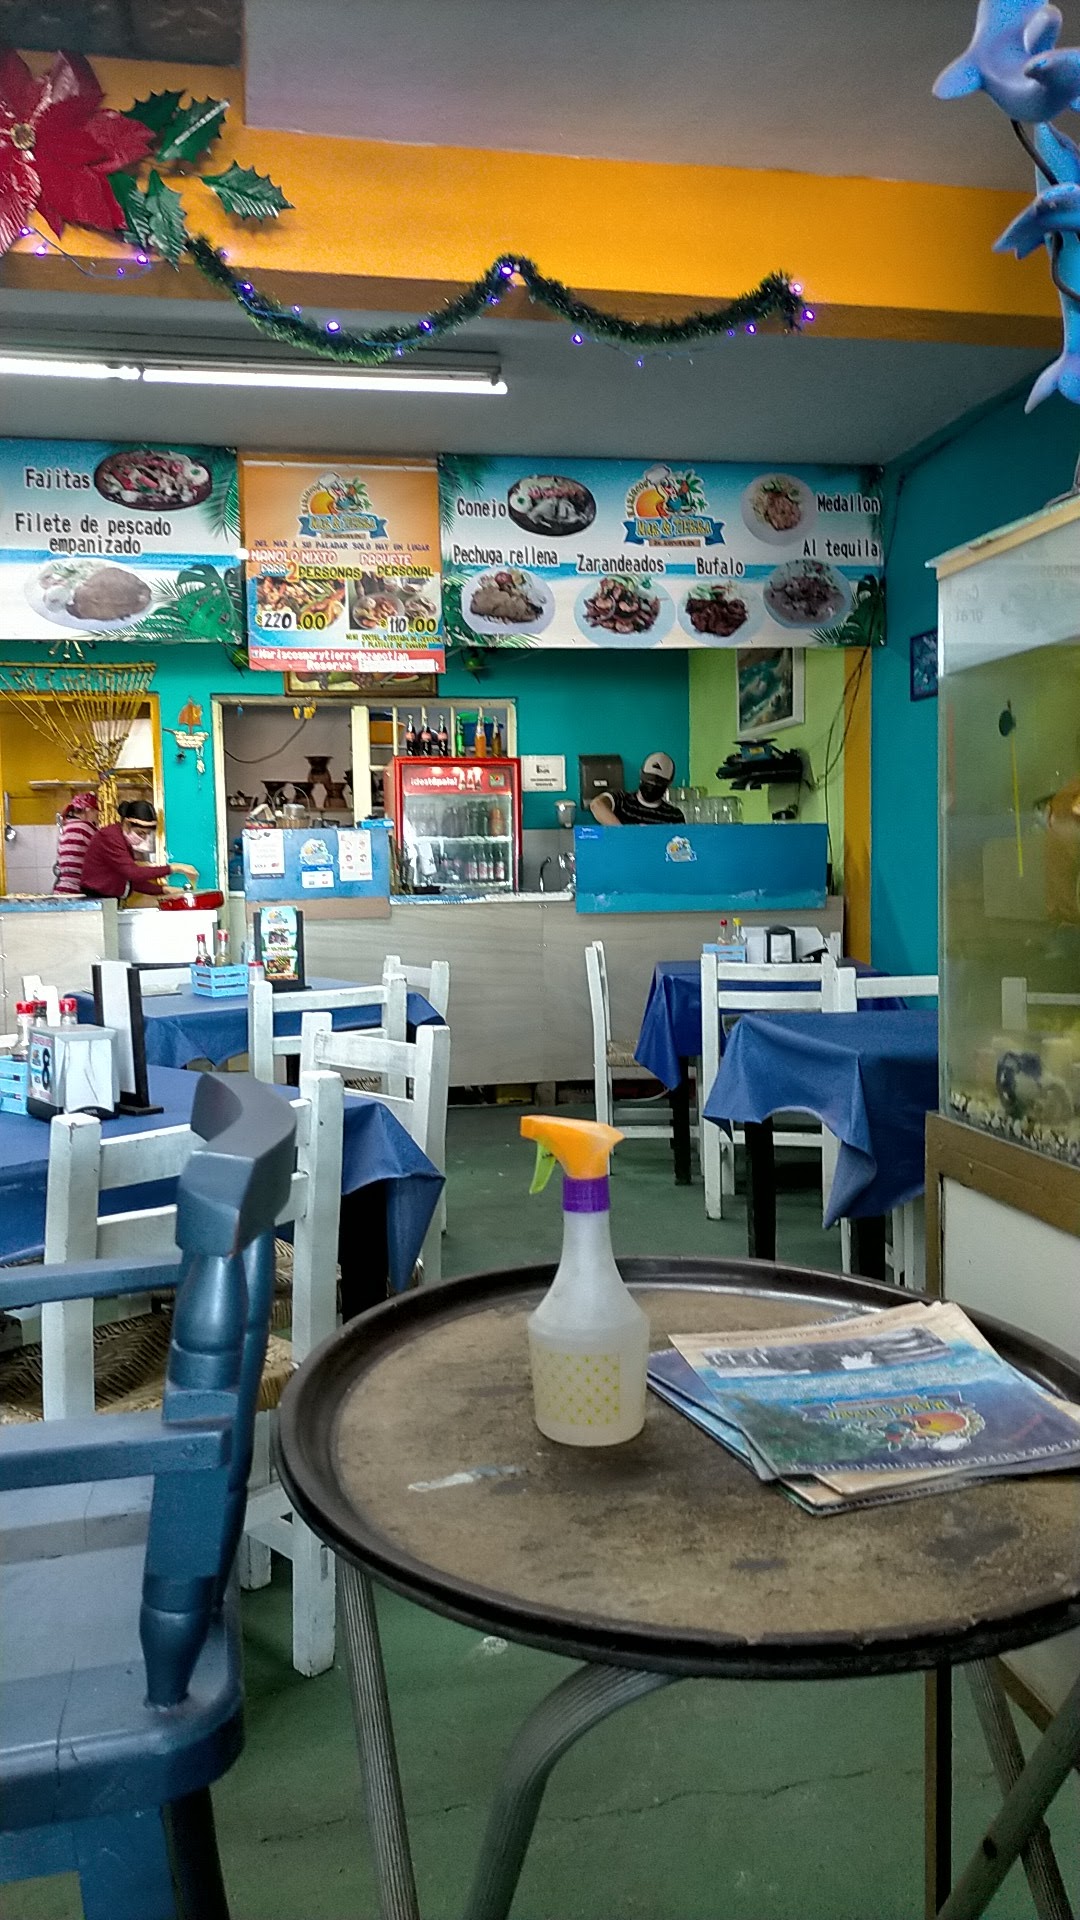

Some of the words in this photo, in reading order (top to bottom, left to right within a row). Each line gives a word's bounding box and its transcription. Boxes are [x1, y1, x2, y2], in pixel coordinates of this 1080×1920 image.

[25, 468, 90, 490] Fajitas
[457, 498, 507, 517] Conejo
[817, 494, 880, 513] Medallon
[15, 512, 72, 533] Filete
[80, 515, 99, 533] de
[108, 517, 172, 536] pescado
[49, 535, 141, 555] empanizado
[316, 541, 348, 549] PALADAR
[803, 539, 816, 557] Al
[826, 539, 878, 558] tequila
[360, 552, 412, 566] PAQUETE
[453, 545, 503, 566] Pechuga
[509, 547, 558, 565] rellena
[577, 554, 664, 573] Zarandeados
[286, 560, 299, 581] 2
[298, 566, 361, 579] PERSONAS
[377, 565, 434, 578] PERSONAL
[697, 557, 744, 576] Bufalo
[42, 1048, 51, 1091] 8
